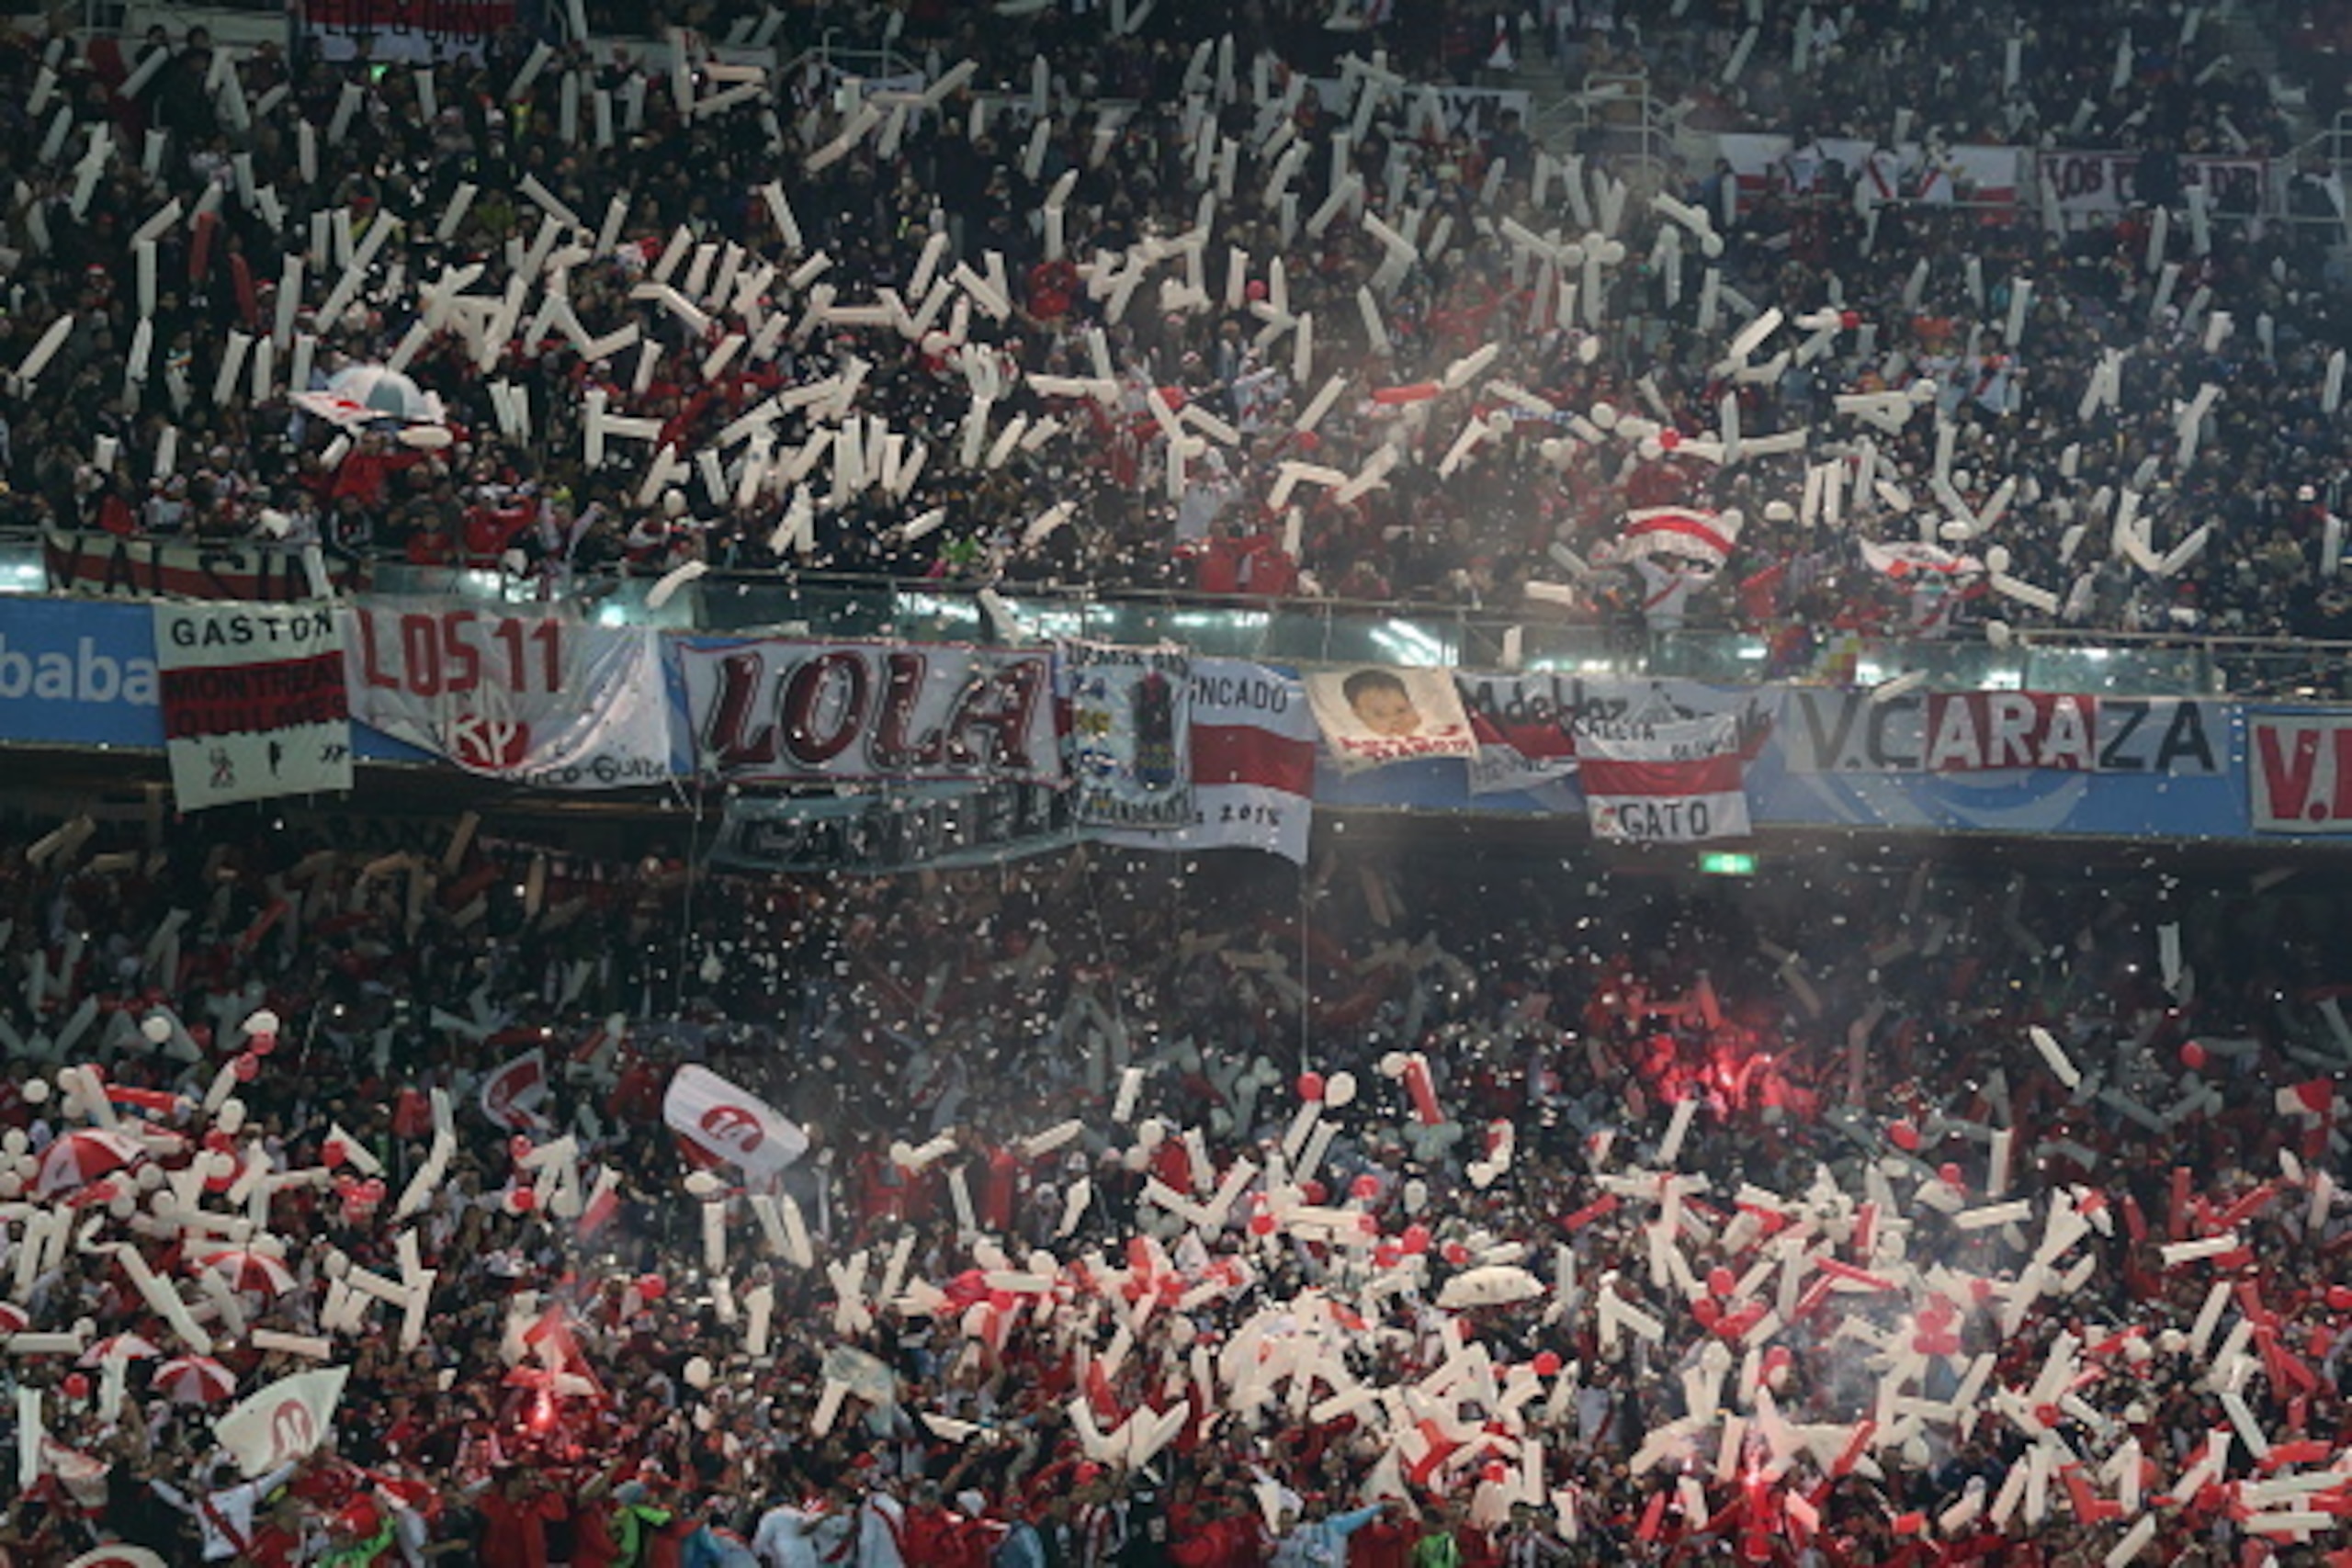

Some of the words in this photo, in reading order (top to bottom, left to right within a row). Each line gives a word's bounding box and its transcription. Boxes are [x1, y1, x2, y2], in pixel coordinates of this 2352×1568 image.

[171, 608, 333, 647] GASTON
[356, 606, 480, 696] LOS
[493, 617, 562, 693] 11
[0, 632, 159, 706] baba
[1190, 677, 1287, 713] NCADO
[700, 649, 1047, 773] LOLA
[1619, 801, 1709, 837] GATO
